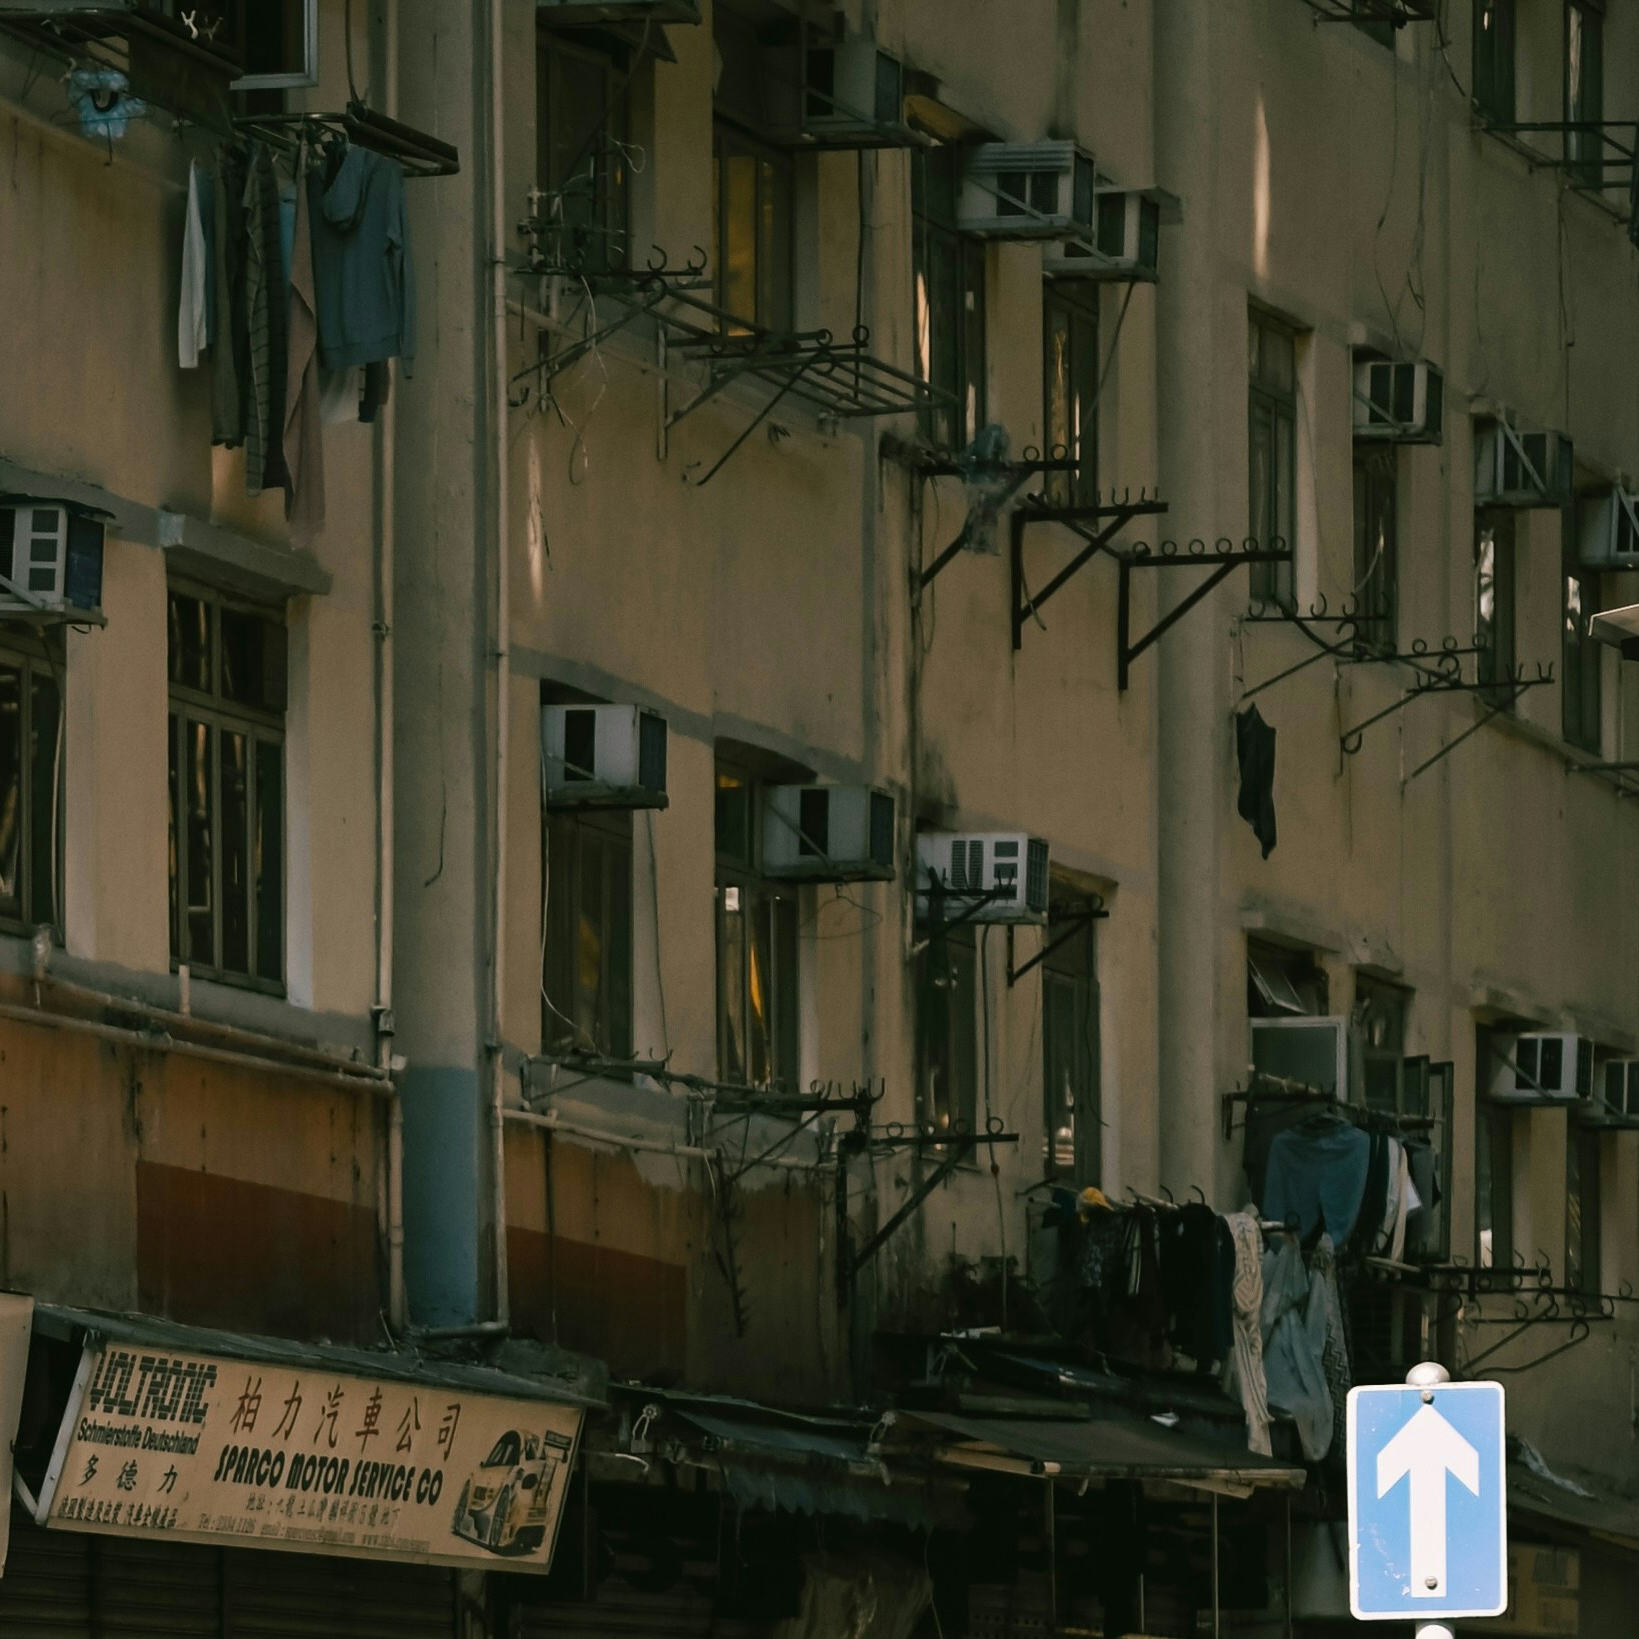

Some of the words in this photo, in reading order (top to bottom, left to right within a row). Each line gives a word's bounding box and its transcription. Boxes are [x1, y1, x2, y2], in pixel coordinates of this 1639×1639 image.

[89, 1350, 218, 1424] VOLTRONIC
[229, 1374, 461, 1461] 柏力汽車公司
[77, 1417, 143, 1449] Schmierstoffe
[142, 1427, 201, 1456] Deutschland
[78, 1454, 179, 1495] 多德力
[213, 1444, 285, 1488] SPARCO
[286, 1453, 351, 1496] MOTOR
[348, 1459, 416, 1502] SERVICE
[415, 1467, 445, 1507] CO
